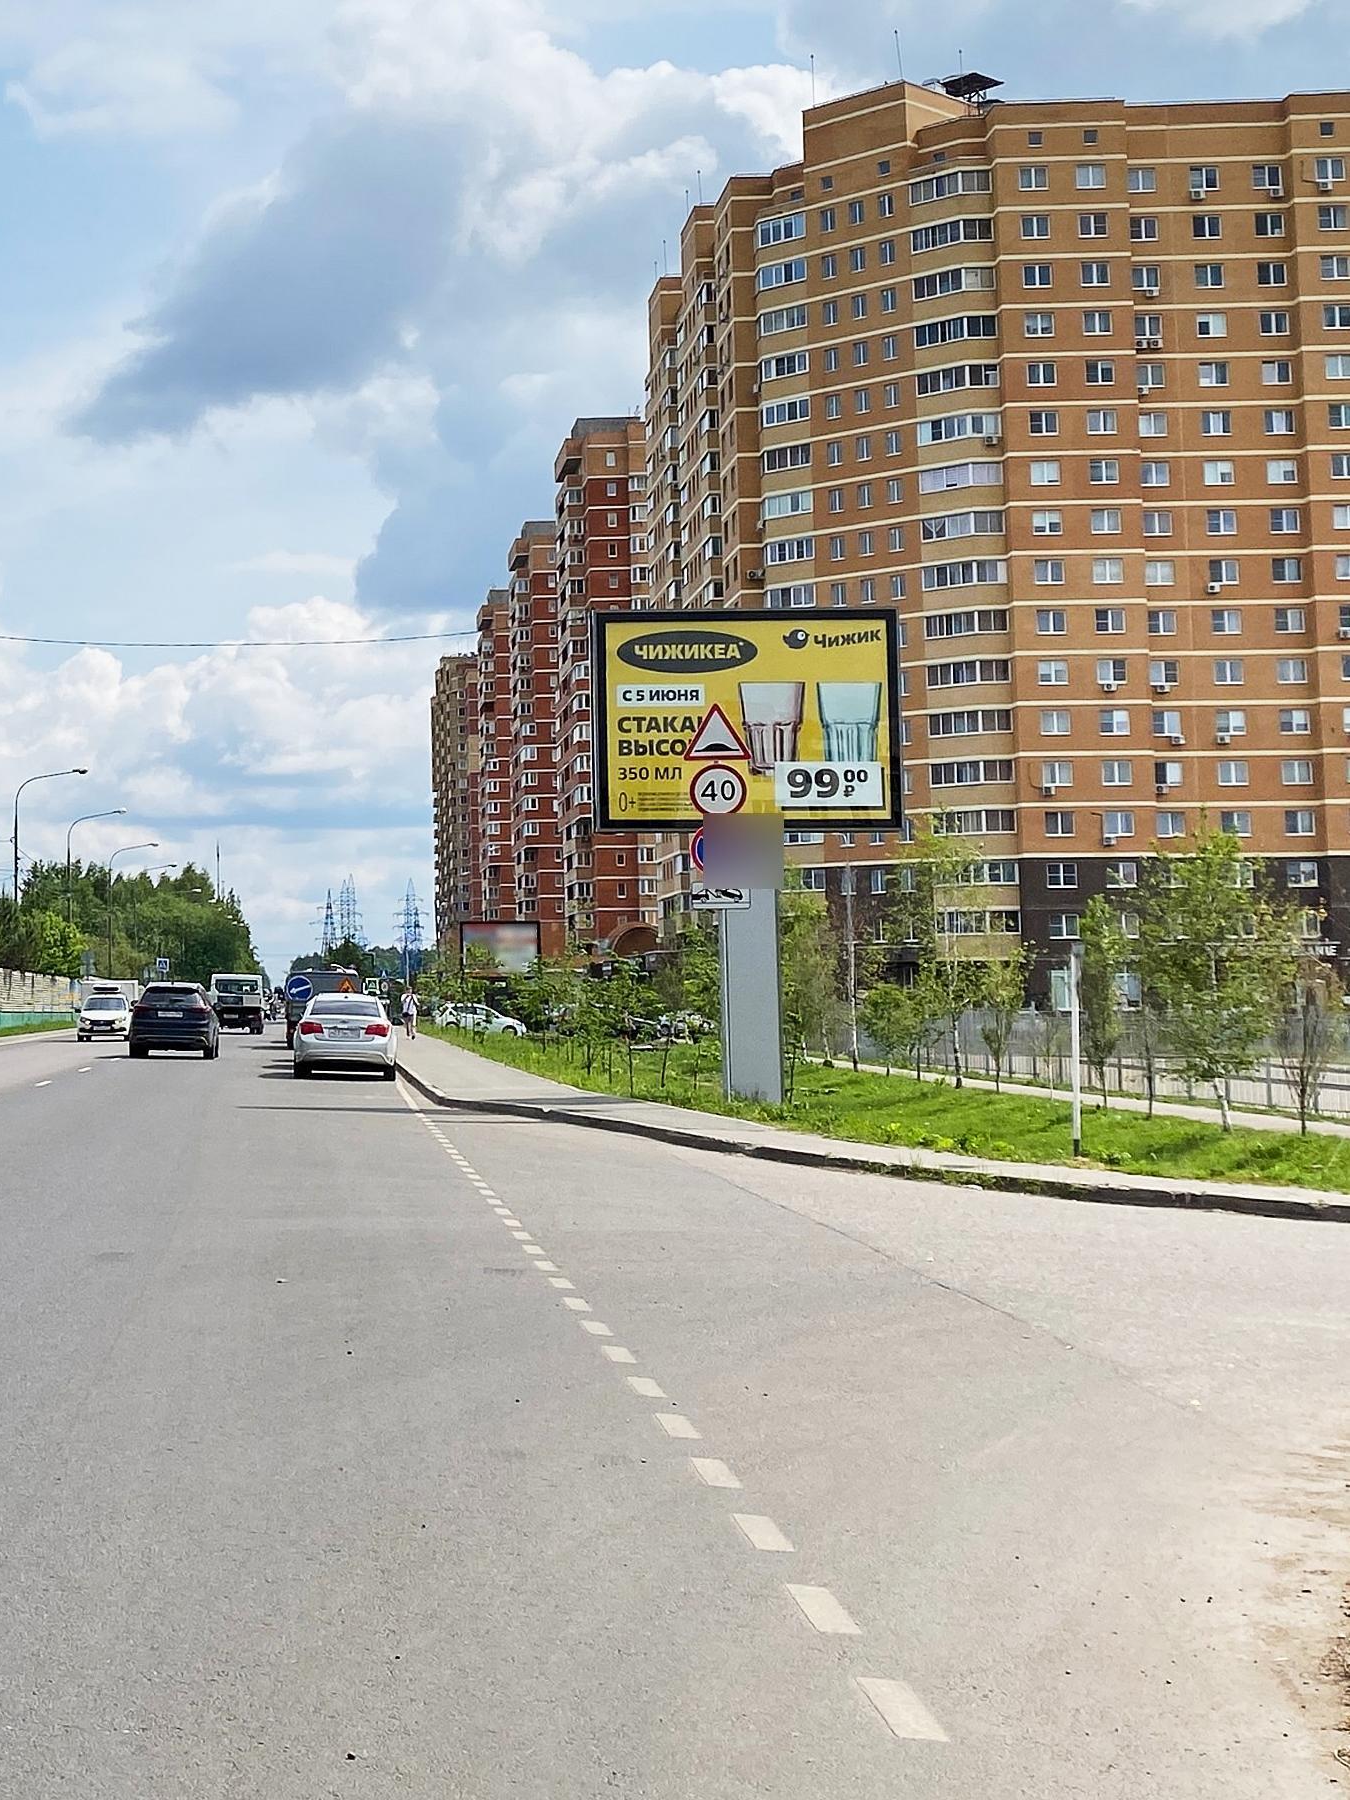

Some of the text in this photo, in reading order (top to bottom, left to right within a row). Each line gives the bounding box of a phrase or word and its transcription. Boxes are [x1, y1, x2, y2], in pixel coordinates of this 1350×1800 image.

[634, 643, 742, 660] ЧИЖИКЕА
[622, 689, 700, 702] С 5 ИЮНЯ
[618, 739, 691, 756] ВЫСО
[618, 767, 682, 780] 350 МЛ
[701, 780, 736, 801] 40
[786, 768, 868, 798] 99 00
[618, 792, 636, 812] 0+
